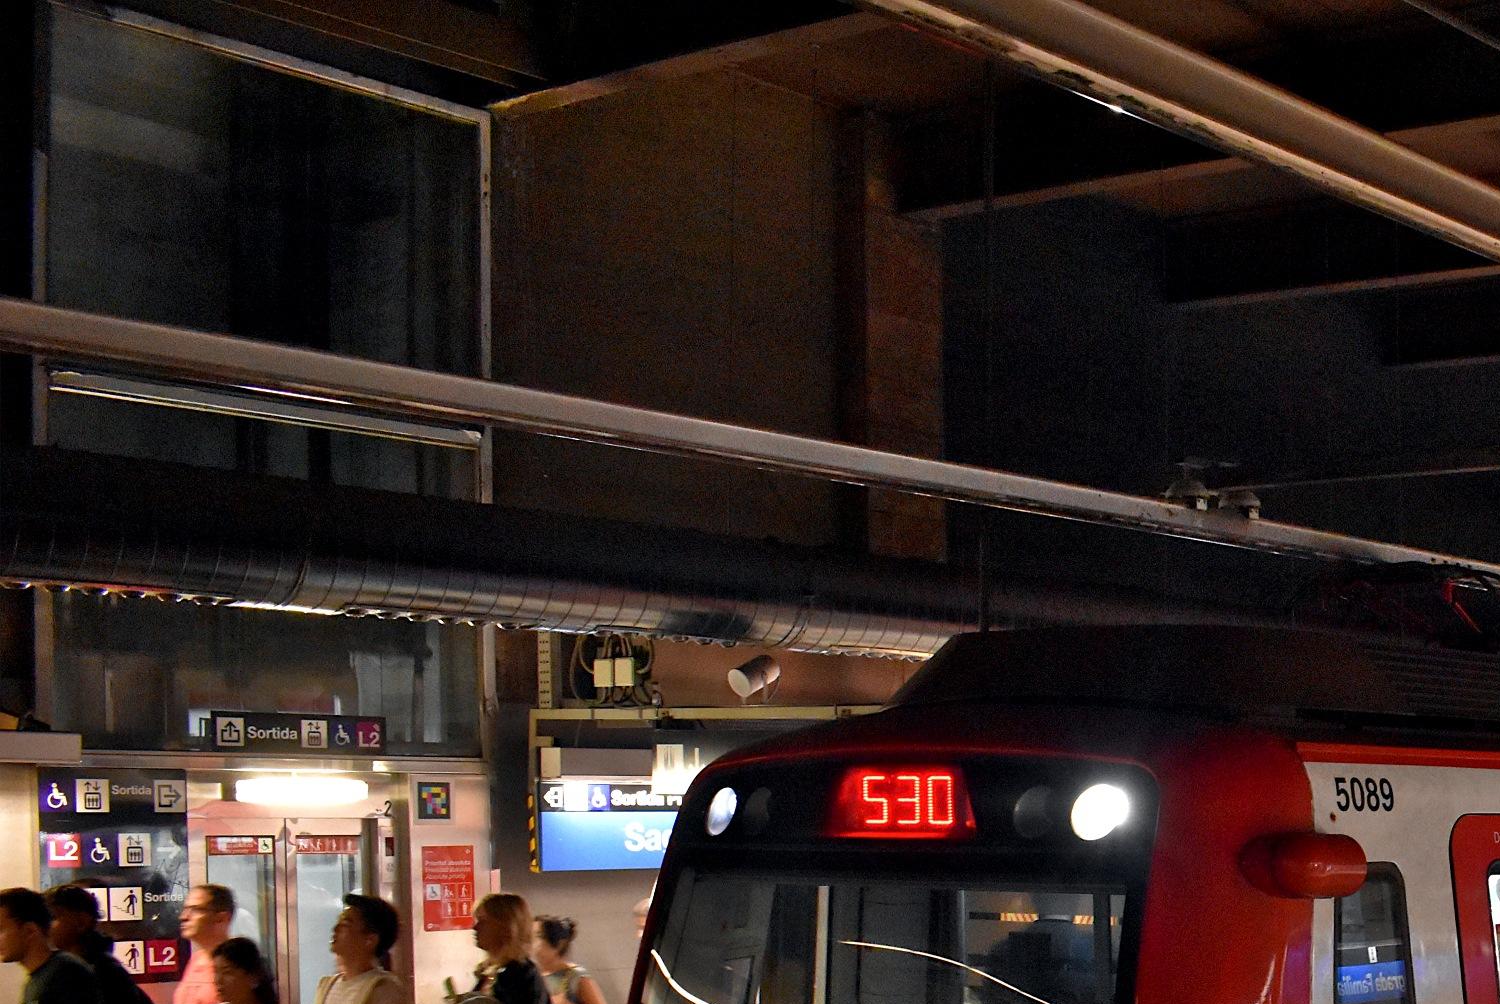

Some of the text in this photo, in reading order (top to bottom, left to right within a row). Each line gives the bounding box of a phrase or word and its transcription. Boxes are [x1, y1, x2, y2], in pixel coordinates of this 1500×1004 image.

[247, 726, 381, 748] Sortida L2
[111, 784, 152, 796] Sortida
[863, 775, 953, 825] 530
[1334, 777, 1395, 812] 5089
[50, 841, 79, 861] L2
[144, 892, 185, 903] Sortida
[149, 947, 176, 967] L2
